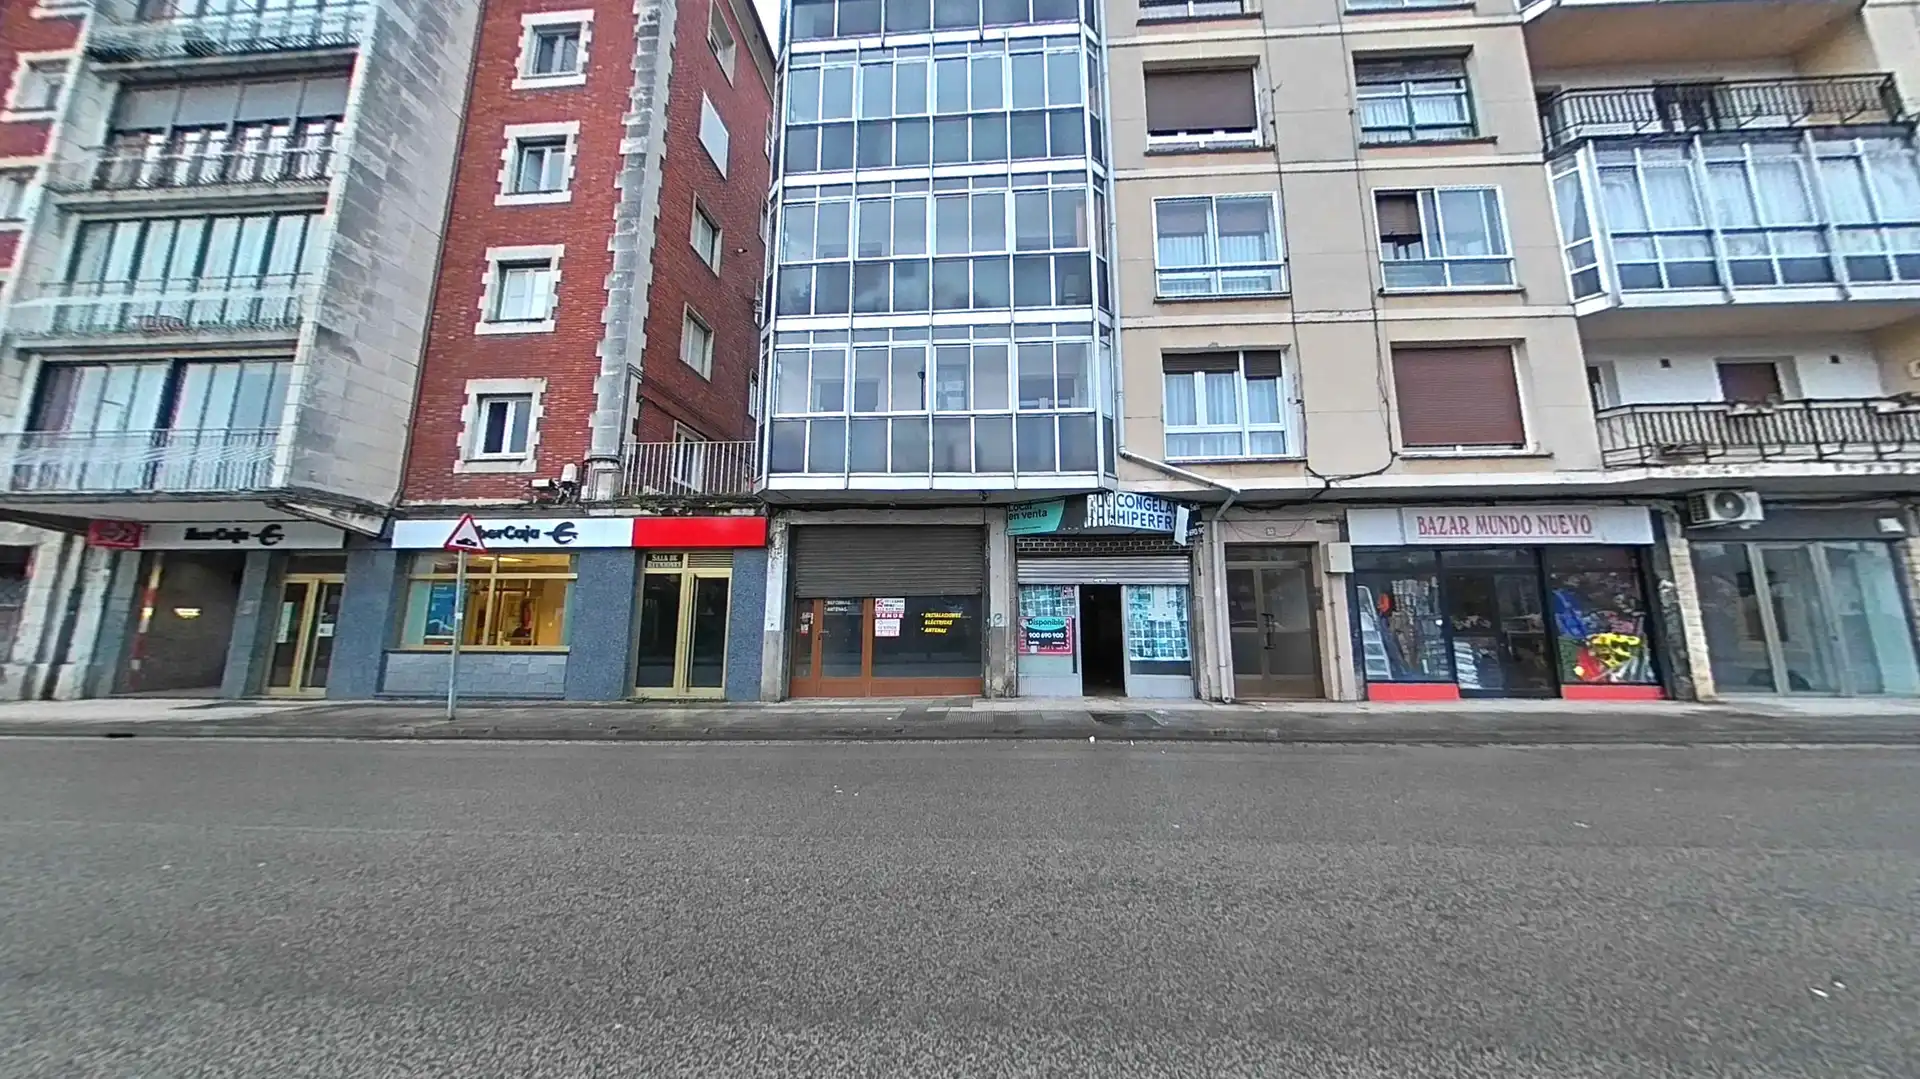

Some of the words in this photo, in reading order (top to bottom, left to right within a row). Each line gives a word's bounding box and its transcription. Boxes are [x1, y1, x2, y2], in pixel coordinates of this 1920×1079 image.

[1008, 502, 1032, 512] Local
[1021, 509, 1048, 519] venta
[1417, 515, 1470, 536] BAZAR
[1475, 514, 1533, 536] MUNDO
[1537, 514, 1592, 536] NUEVO
